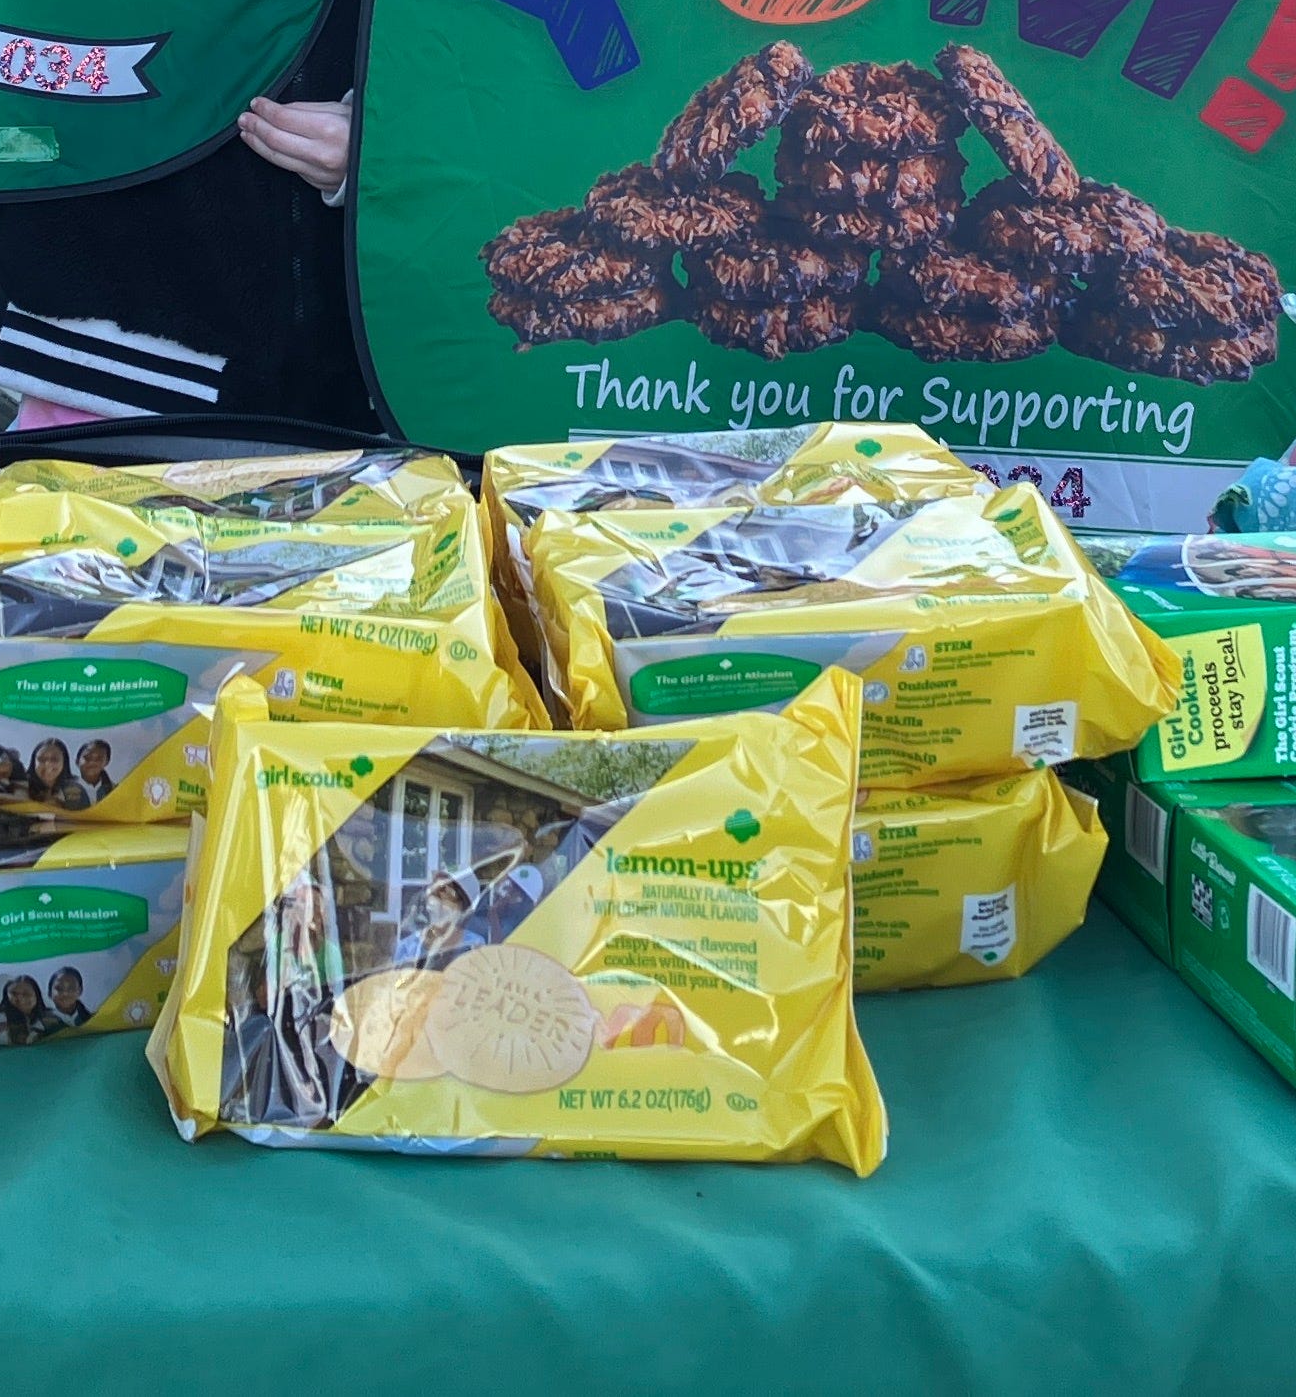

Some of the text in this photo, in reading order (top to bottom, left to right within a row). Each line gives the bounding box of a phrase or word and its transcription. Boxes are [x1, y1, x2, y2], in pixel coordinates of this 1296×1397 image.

[566, 359, 1196, 455] Thank you for Supporting
[300, 615, 438, 656] NET WT 6.2 OZ(176g)
[934, 640, 972, 653] STEM
[16, 677, 159, 692] The Girl Scout Mission
[306, 671, 344, 690] STEM
[655, 668, 793, 686] The Girl Scout Mission
[897, 679, 958, 691] Outdoors
[1217, 631, 1244, 730] stay local.
[1202, 661, 1231, 751] proceeds
[1273, 646, 1288, 763] The Girl Scout
[1166, 717, 1187, 759] Girl
[257, 765, 354, 790] girl scouts
[878, 826, 917, 840] STEM
[606, 847, 760, 885] lemon-ups
[642, 884, 702, 900] NATURALLY
[0, 912, 25, 926] Girl
[28, 910, 64, 920] Scout
[67, 908, 119, 920] Mission
[661, 905, 758, 923] NATURAL FLAVORS
[701, 938, 757, 954] flavored
[604, 954, 654, 967] cookies
[559, 1087, 711, 1113] NET WT 6.2 OZ(176g)
